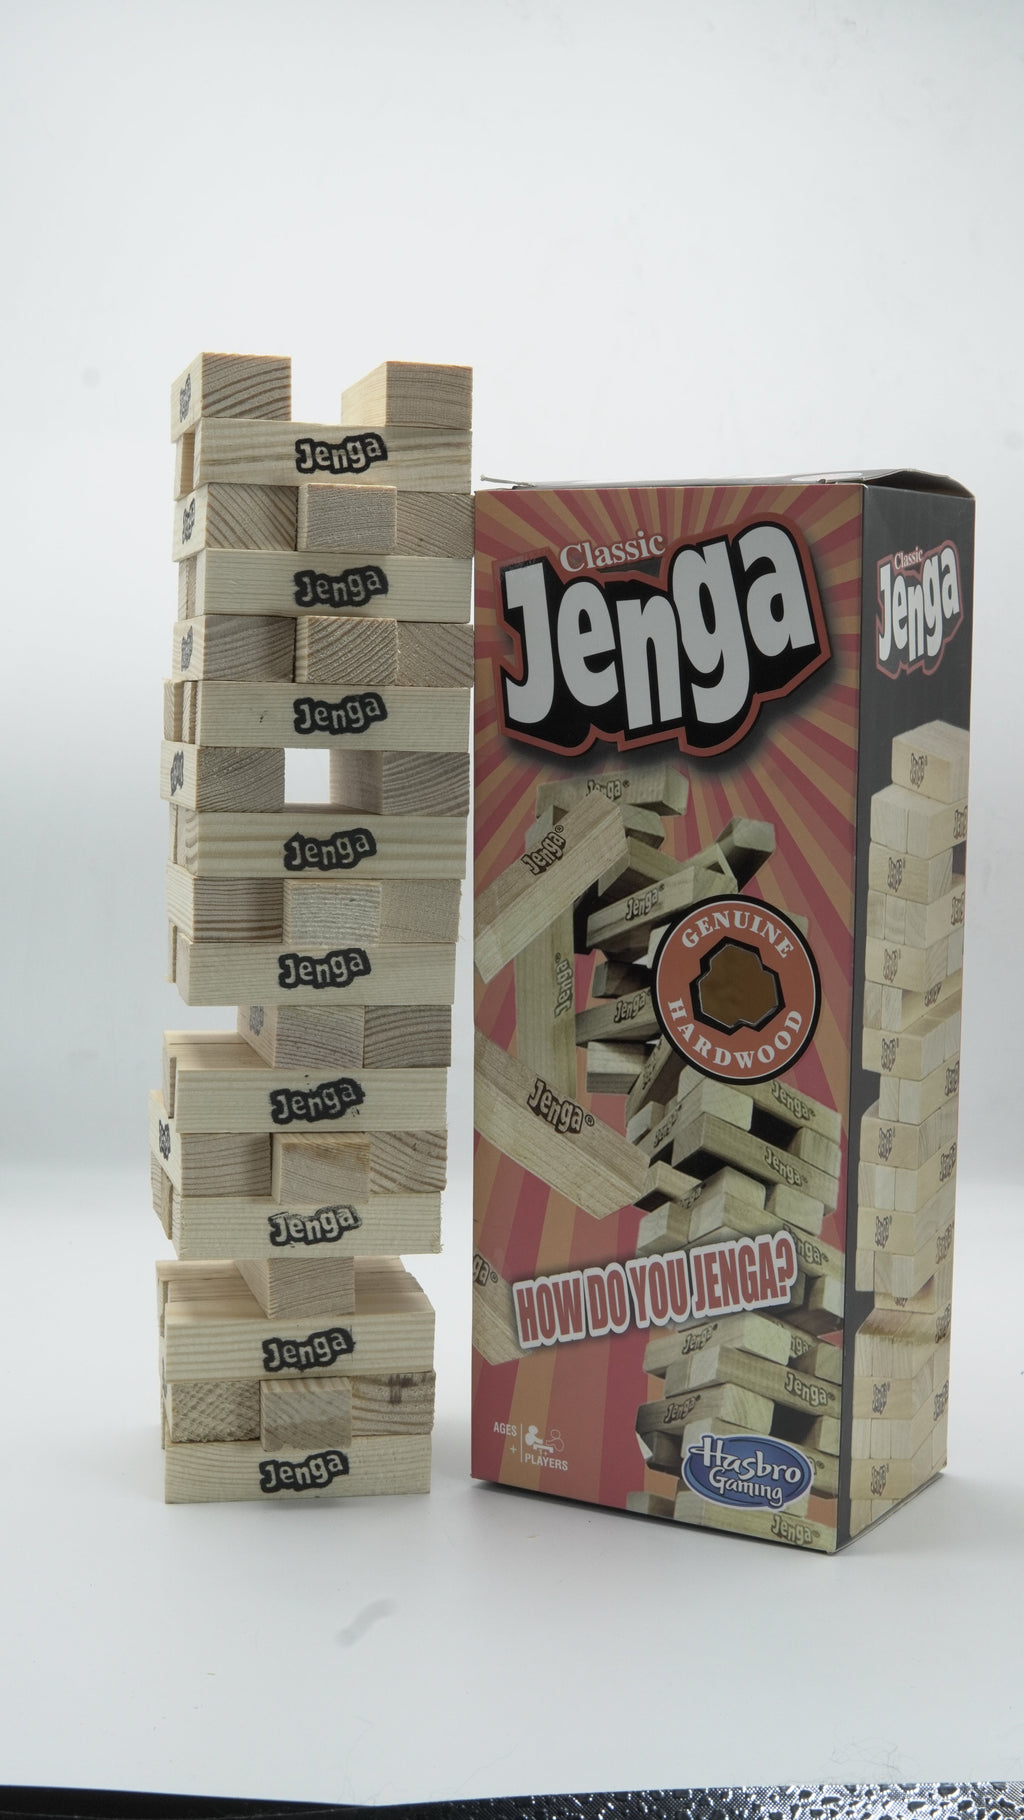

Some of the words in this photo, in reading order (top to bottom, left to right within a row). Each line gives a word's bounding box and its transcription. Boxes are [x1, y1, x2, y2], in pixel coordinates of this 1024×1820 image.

[298, 436, 383, 471] Jenga
[559, 531, 667, 573] Classic
[894, 546, 924, 570] Classic
[300, 569, 383, 604] Jenga
[878, 546, 961, 663] Jenga
[504, 525, 817, 731] Jenga
[297, 696, 383, 731] Jenga
[289, 833, 370, 866] Jenga
[682, 910, 794, 959] GENUINE
[279, 951, 366, 986] Jenga
[668, 998, 803, 1069] HARDWOOD
[275, 1083, 358, 1120] Jenga
[271, 1206, 359, 1242] Jenga
[516, 1276, 584, 1343] HOW
[586, 1269, 628, 1331] DO
[629, 1256, 689, 1323] YOU
[693, 1237, 795, 1313] JENGA?
[267, 1329, 348, 1367] Jenga
[494, 1421, 517, 1437] AGES
[264, 1451, 345, 1488] Jenga
[525, 1452, 568, 1472] PLAYERS
[690, 1436, 801, 1484] Hasbro
[709, 1466, 783, 1507] Gaming
